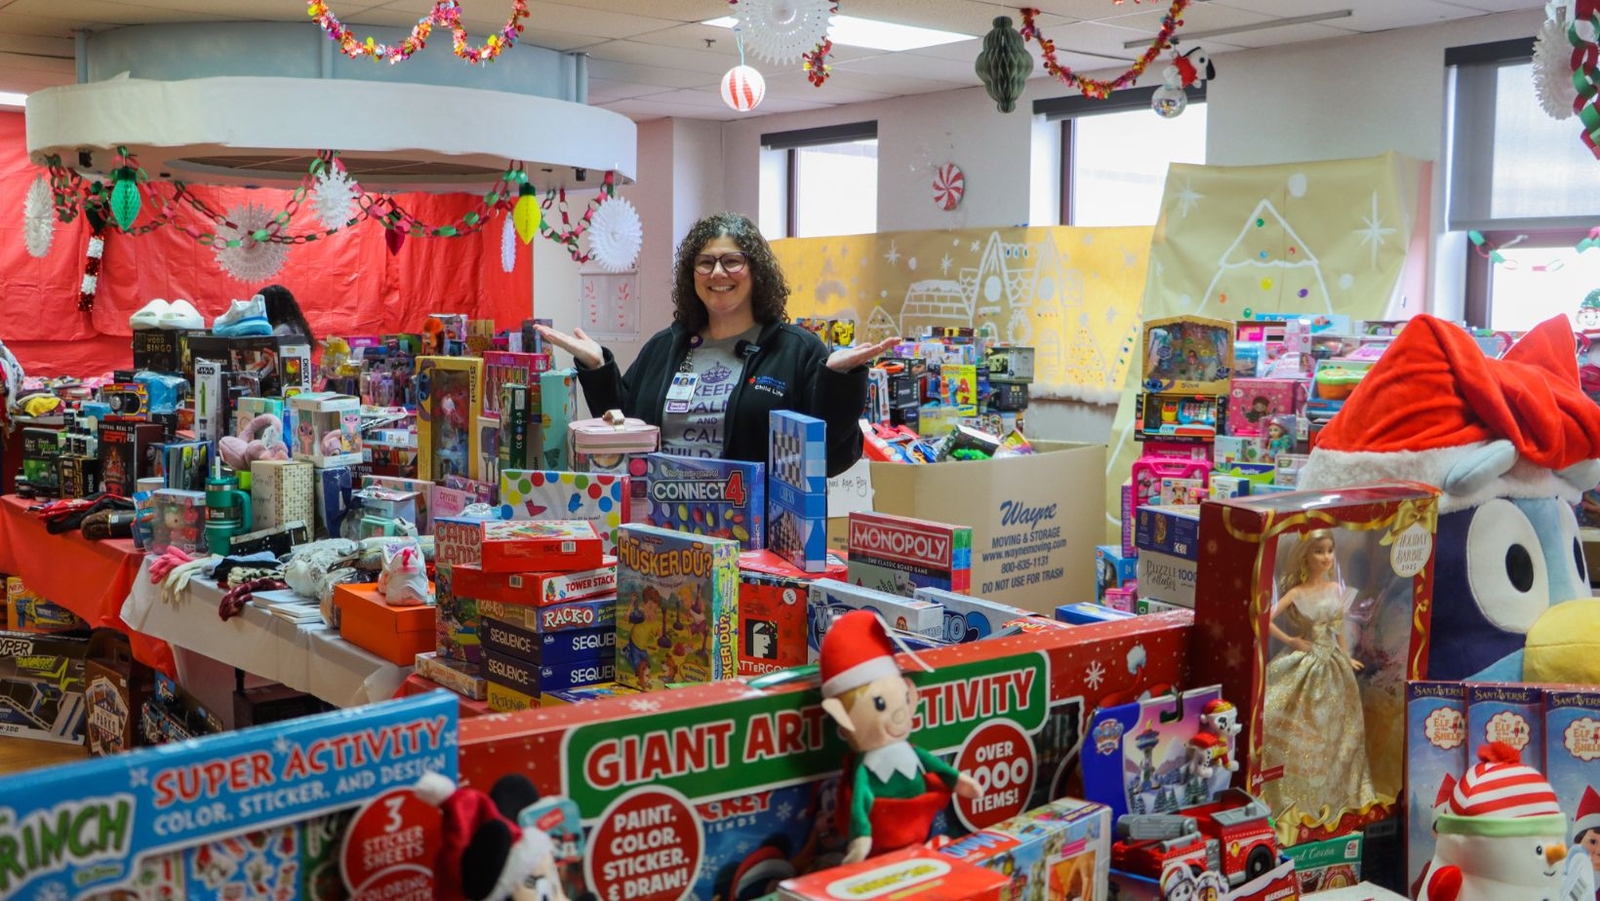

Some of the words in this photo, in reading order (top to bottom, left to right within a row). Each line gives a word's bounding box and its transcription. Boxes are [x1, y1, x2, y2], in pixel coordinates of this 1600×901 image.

[696, 418, 718, 426] AND
[683, 429, 723, 444] CAL
[653, 482, 726, 500] CONNECT
[725, 471, 746, 507] 4
[1000, 500, 1057, 530] Wayne
[435, 522, 479, 546] CAND
[853, 526, 946, 560] MONOPOLY
[991, 534, 1022, 549] MOVING
[1029, 526, 1061, 542] STORAGE
[982, 538, 1067, 563] www.waynemoving.com
[9, 583, 25, 592] NER
[565, 578, 593, 592] TOWER
[592, 574, 616, 587] STACK
[982, 581, 993, 594] DO
[994, 578, 1009, 591] NOT
[1010, 575, 1025, 588] USE
[1026, 572, 1040, 585] FOR
[1041, 567, 1064, 581] TRASH
[490, 628, 531, 652] SEQUENCE
[572, 632, 616, 651] SEQUEN
[488, 658, 529, 685] SEQUENCE
[570, 665, 616, 683] SEQUEN
[585, 719, 736, 790] GIANT
[743, 704, 829, 763] ART
[975, 740, 1013, 763] OVER
[154, 751, 275, 807] SUPER
[283, 716, 447, 780] ACTIVITY
[961, 757, 1029, 793] 000
[153, 802, 234, 836] COLOR.
[239, 780, 331, 817] STICKER.
[335, 769, 376, 795] AND
[380, 754, 447, 785] DESIGN
[696, 790, 773, 822] CKEY
[970, 790, 1019, 815] ITEMS!
[384, 795, 406, 833] 3
[613, 804, 678, 832] PAINT.
[0, 797, 131, 891] RINCH
[363, 825, 424, 853] STICKER
[610, 827, 682, 857] COLOR.
[363, 840, 424, 871] SHEETS
[602, 848, 691, 882] STICKER.
[607, 883, 621, 901] &
[623, 867, 689, 900] DRAW!
